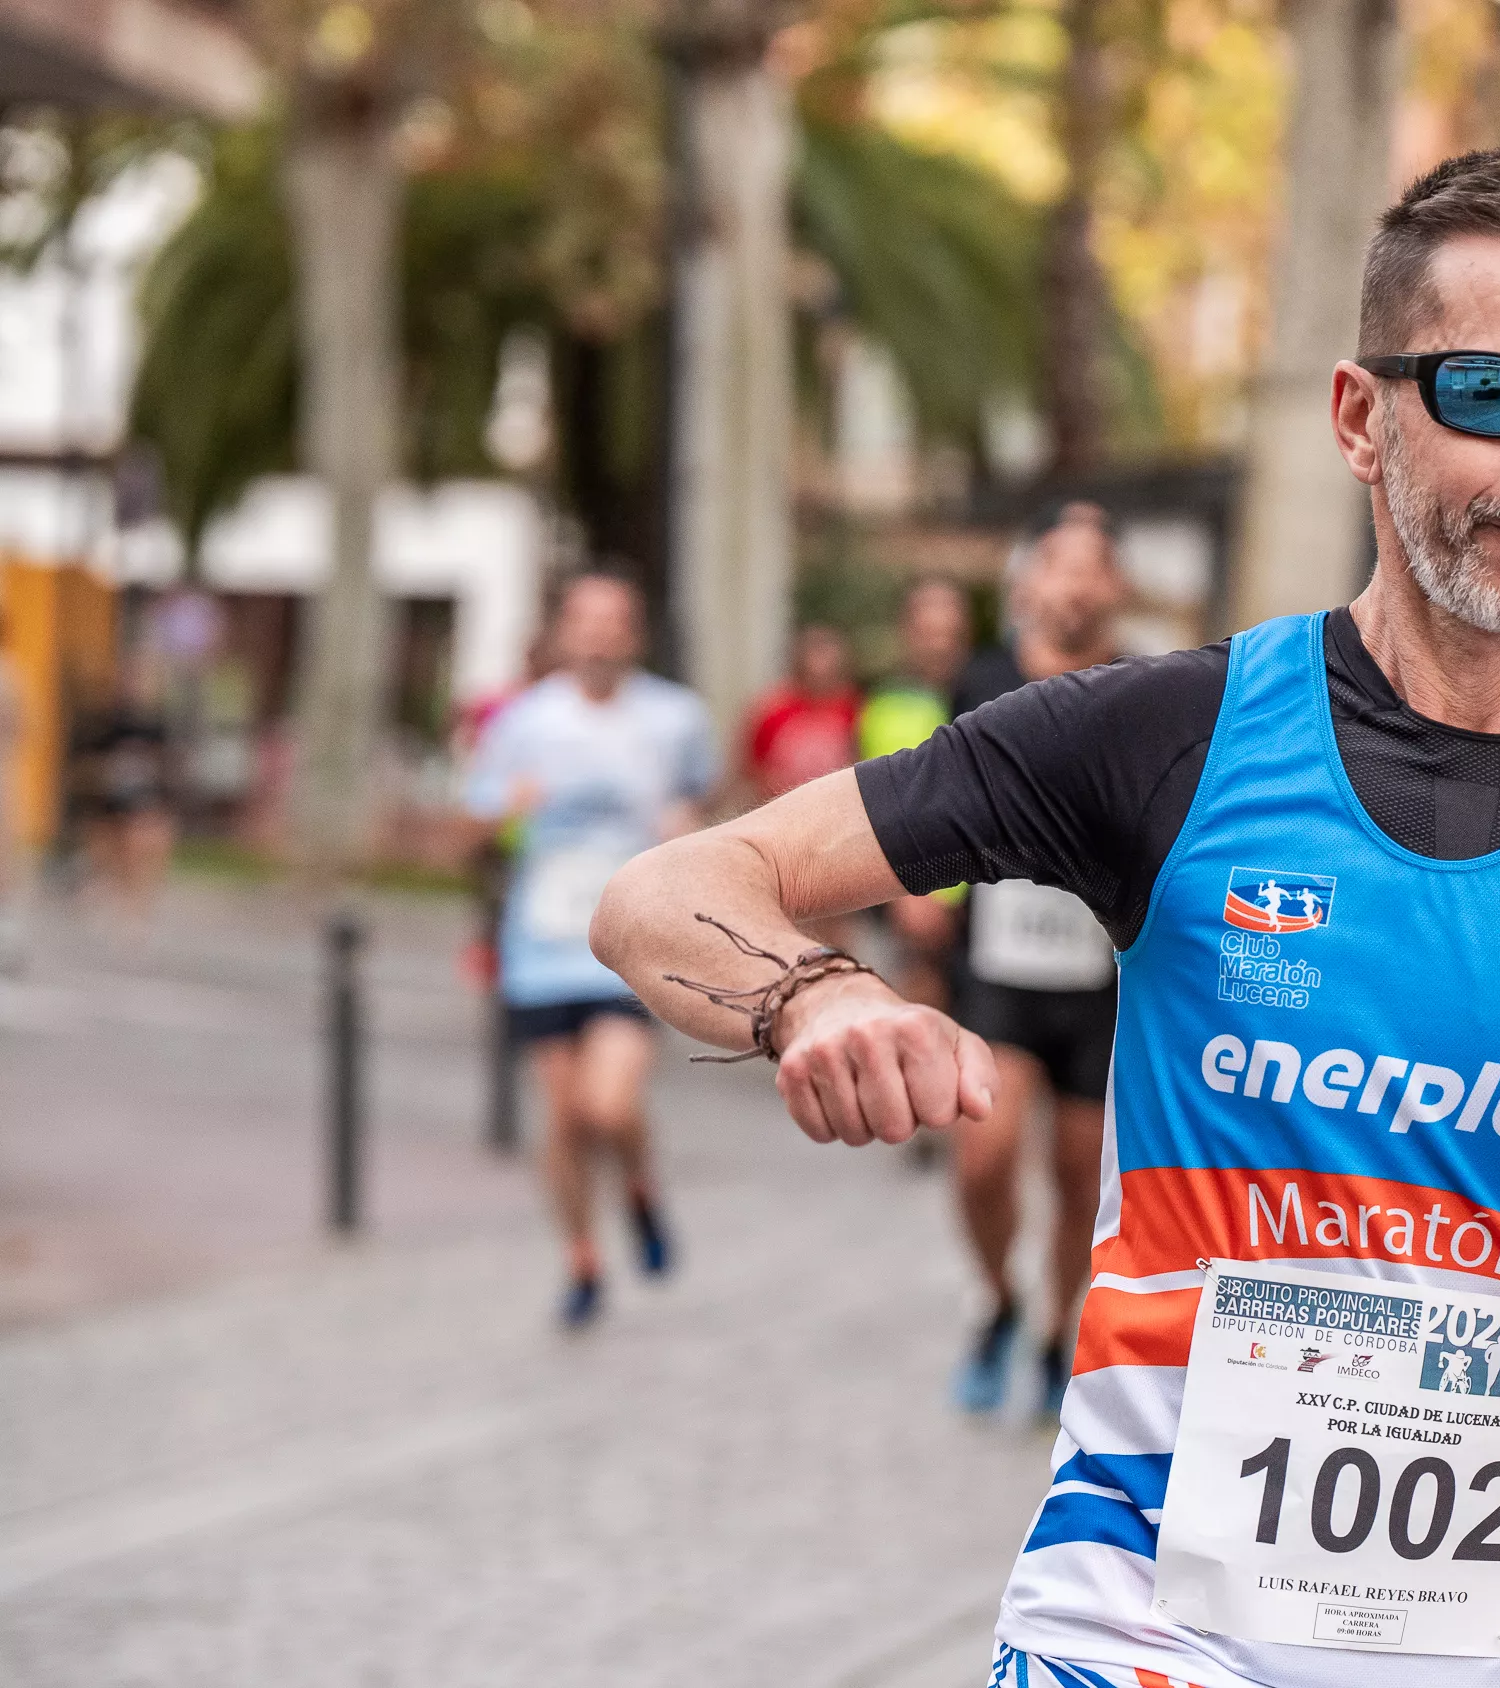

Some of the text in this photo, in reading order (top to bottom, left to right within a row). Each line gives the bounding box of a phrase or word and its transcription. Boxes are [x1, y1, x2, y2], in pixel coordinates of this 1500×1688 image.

[1220, 930, 1281, 960] Club
[1219, 953, 1322, 989] Maratón
[1217, 976, 1310, 1010] Lucena
[1216, 1277, 1423, 1320] CIRCUITO PROVINCIAL DE
[1215, 1295, 1420, 1339] CARRERAS POPULARES
[1212, 1316, 1418, 1354] DIPUTACIÓN DE CÓRDOBA
[1226, 1357, 1257, 1367] Diputación
[1337, 1365, 1380, 1380] IMDECO
[1296, 1392, 1500, 1428] XXV C.P. CIUDAD DE LUCENA
[1327, 1417, 1462, 1446] POR LA IGUALDAD
[1258, 1576, 1468, 1604] LUIS RAFAEL REYES BRAVO
[1324, 1608, 1399, 1621] HORA APROXIMADA
[1342, 1619, 1379, 1629] CARRERA
[1336, 1627, 1382, 1637] 09:00 HORAS
